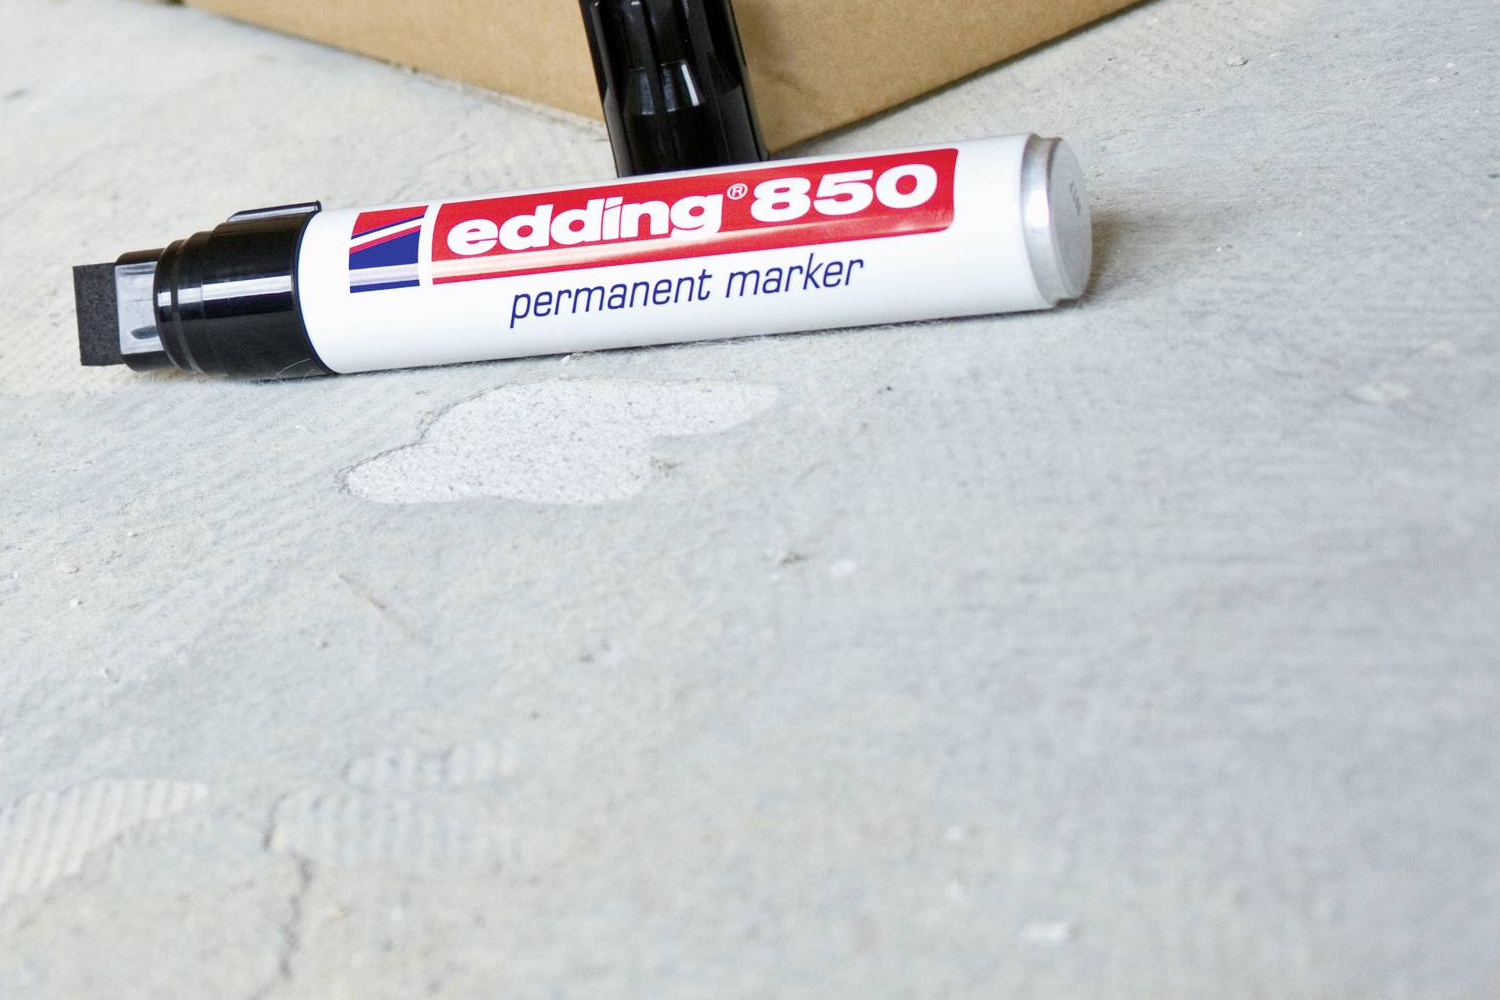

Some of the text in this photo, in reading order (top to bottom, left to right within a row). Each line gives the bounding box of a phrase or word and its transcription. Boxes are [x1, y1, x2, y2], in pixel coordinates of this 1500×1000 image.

[750, 163, 938, 222] 850
[510, 253, 865, 329] permanent marker
